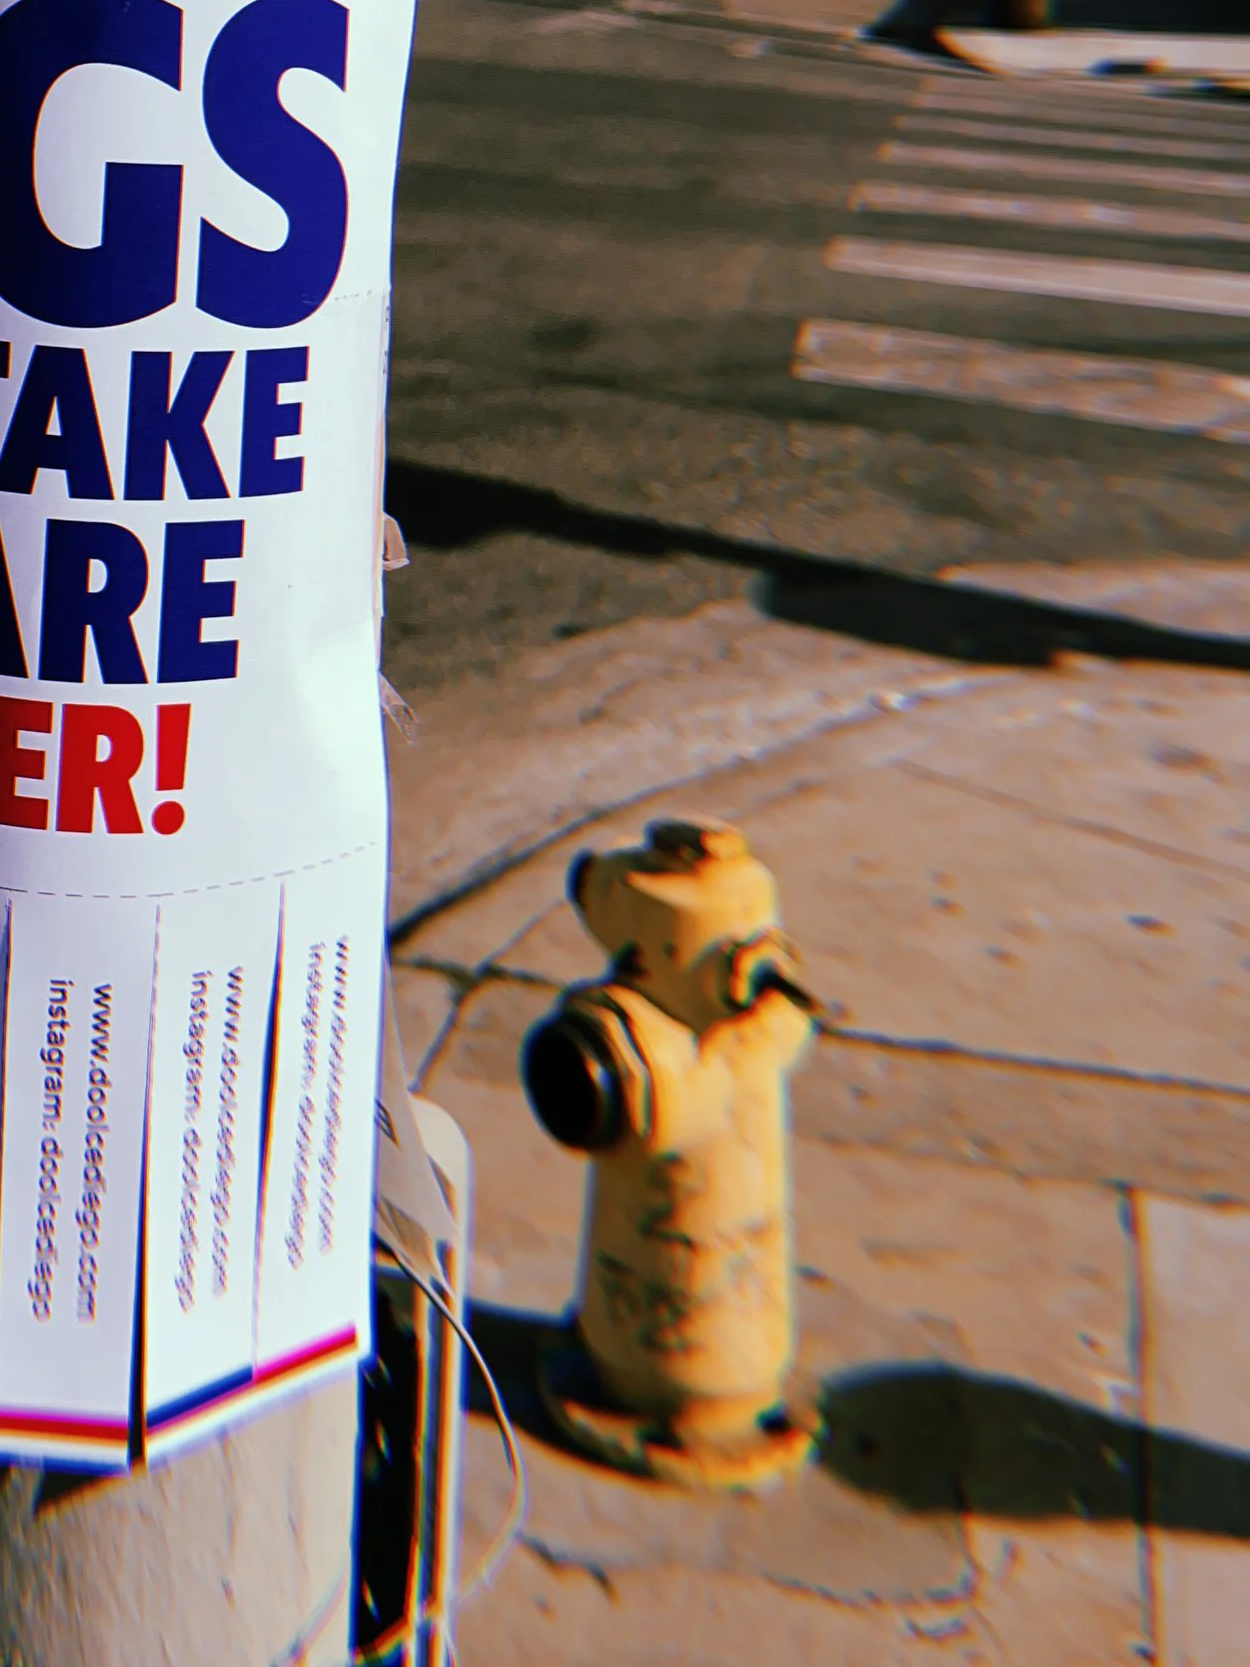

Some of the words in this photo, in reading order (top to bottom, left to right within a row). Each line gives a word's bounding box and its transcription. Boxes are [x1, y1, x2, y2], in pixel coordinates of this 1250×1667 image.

[40, 979, 75, 1129] instagram:
[28, 1137, 63, 1319] doolcediego
[74, 983, 112, 1322] www.doolcediego.com
